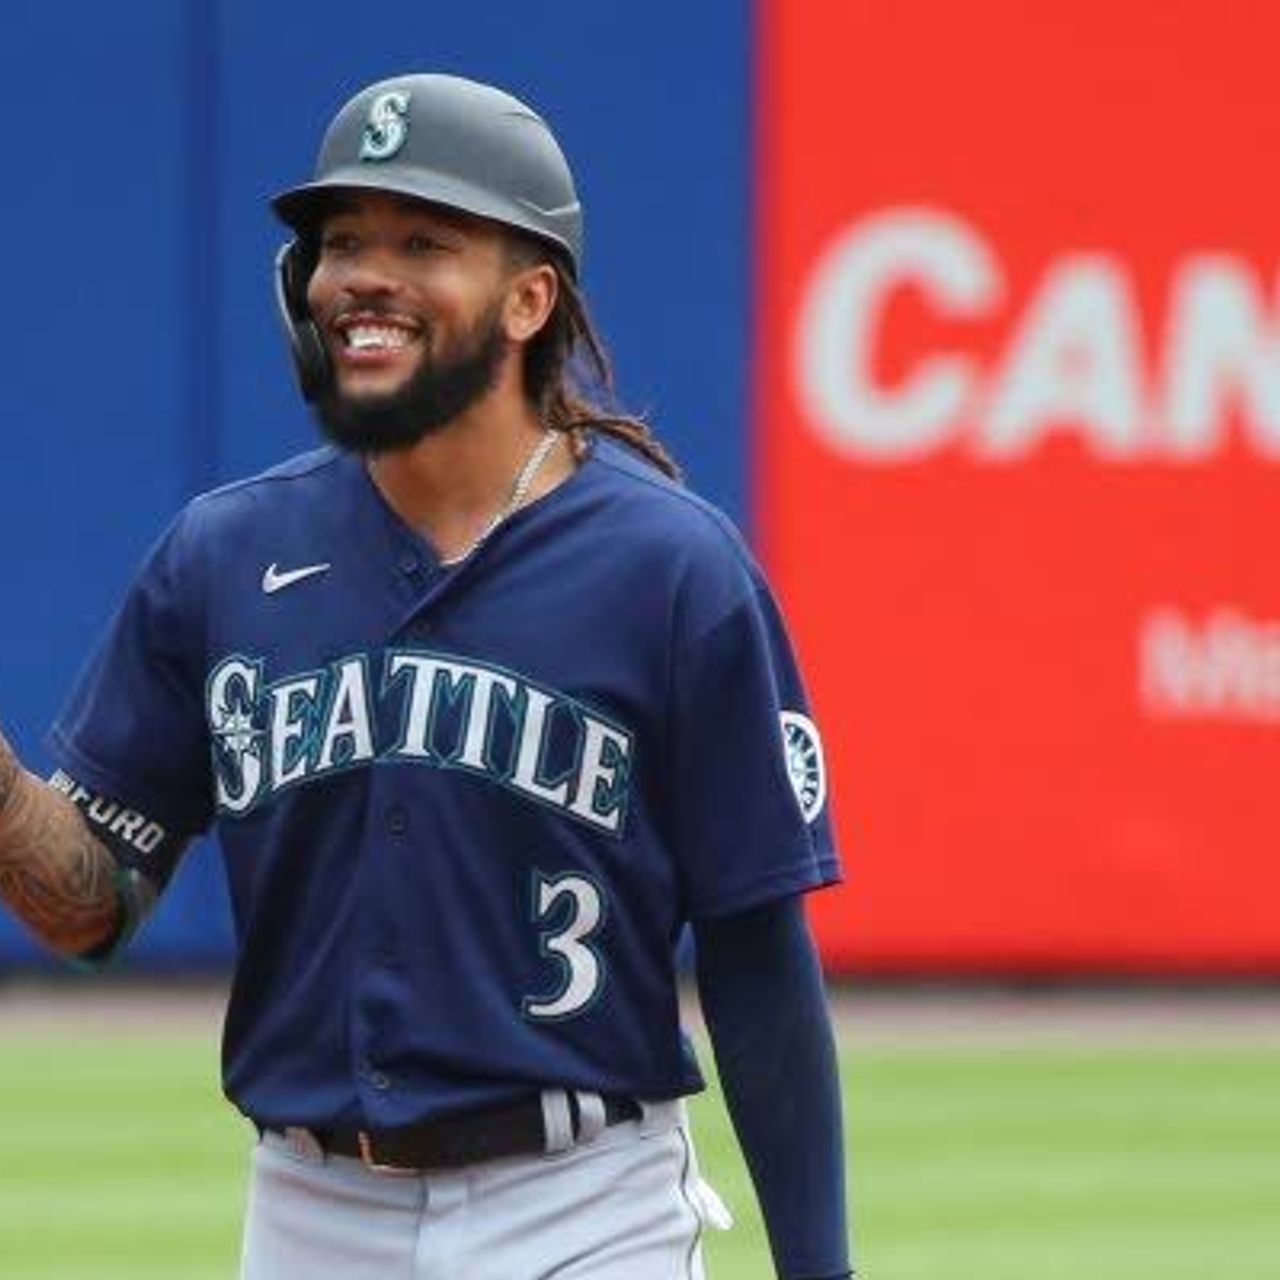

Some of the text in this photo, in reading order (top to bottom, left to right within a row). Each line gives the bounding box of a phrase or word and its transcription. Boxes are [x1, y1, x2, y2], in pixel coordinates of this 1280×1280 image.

[358, 90, 412, 161] S
[207, 648, 635, 838] SEATTLE
[525, 870, 606, 1020] 3
